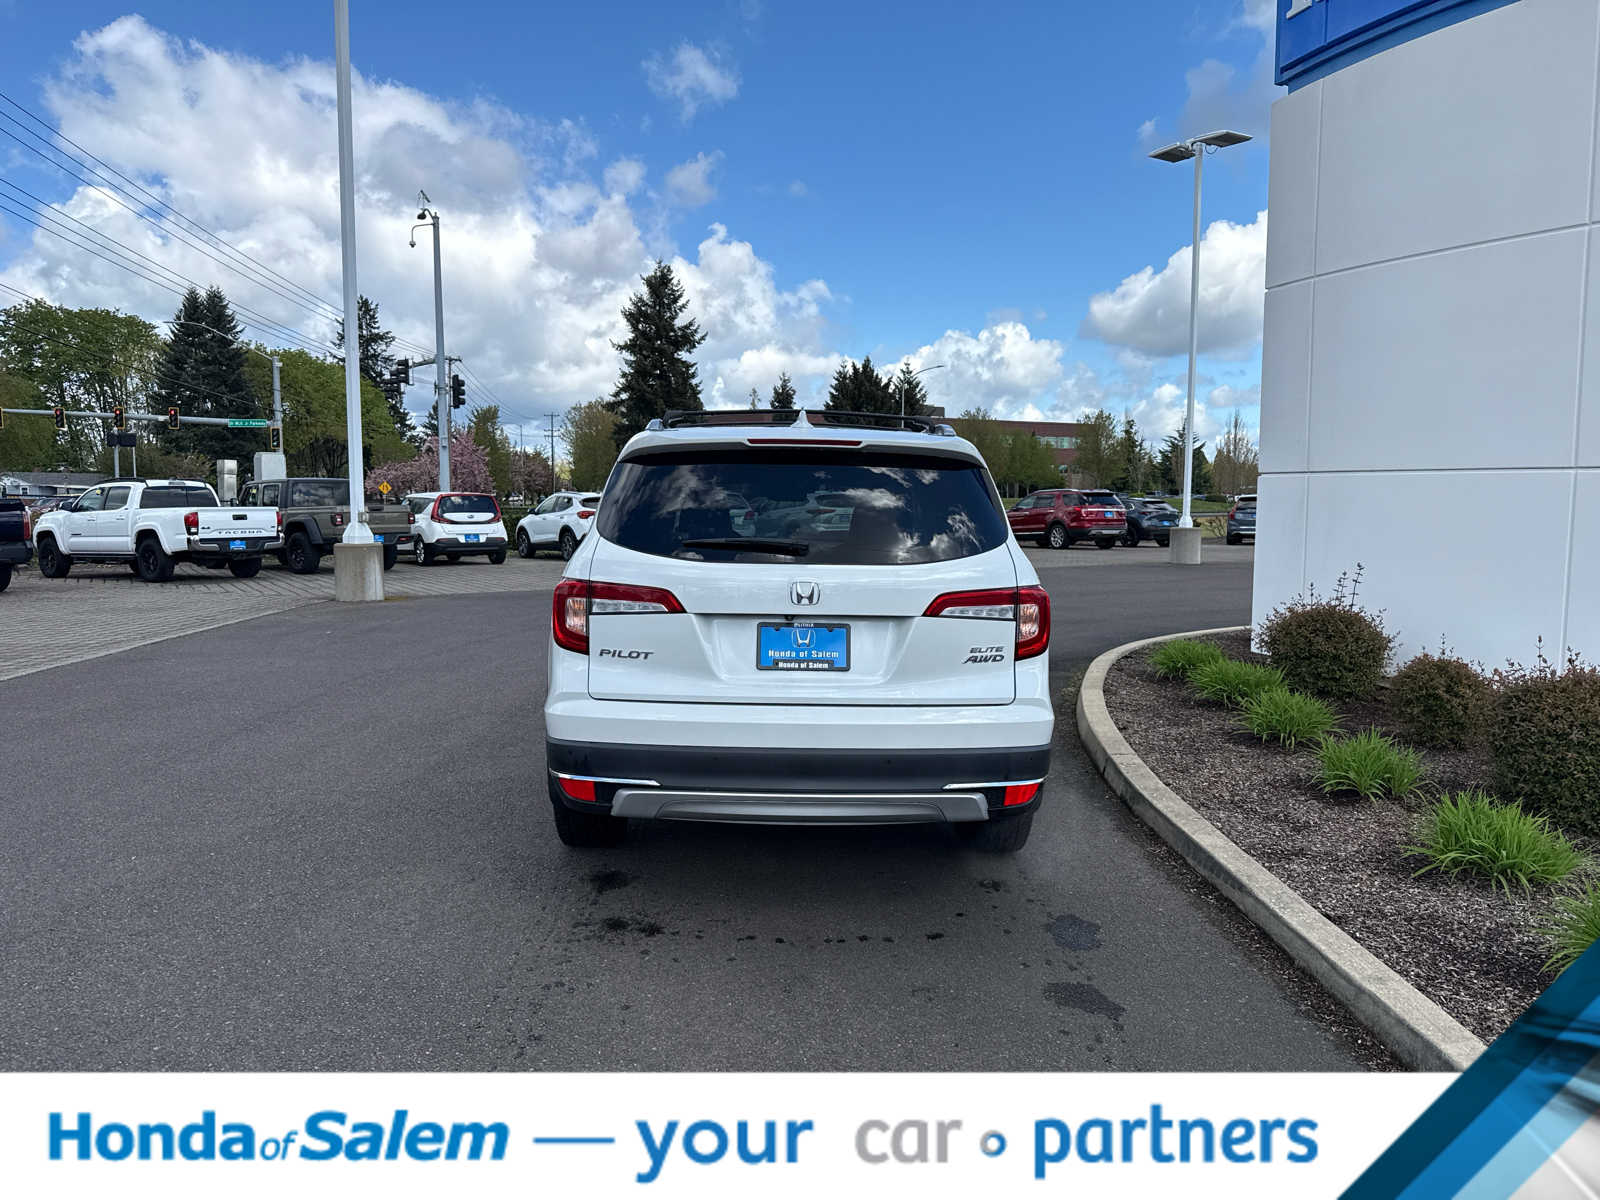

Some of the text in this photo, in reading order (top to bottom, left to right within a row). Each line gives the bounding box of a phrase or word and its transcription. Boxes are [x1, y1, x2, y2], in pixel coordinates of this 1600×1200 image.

[599, 648, 654, 660] PILOT
[768, 649, 839, 658] Honda of Salem
[962, 654, 1005, 664] AWD
[778, 661, 799, 669] Honda
[800, 661, 808, 669] of
